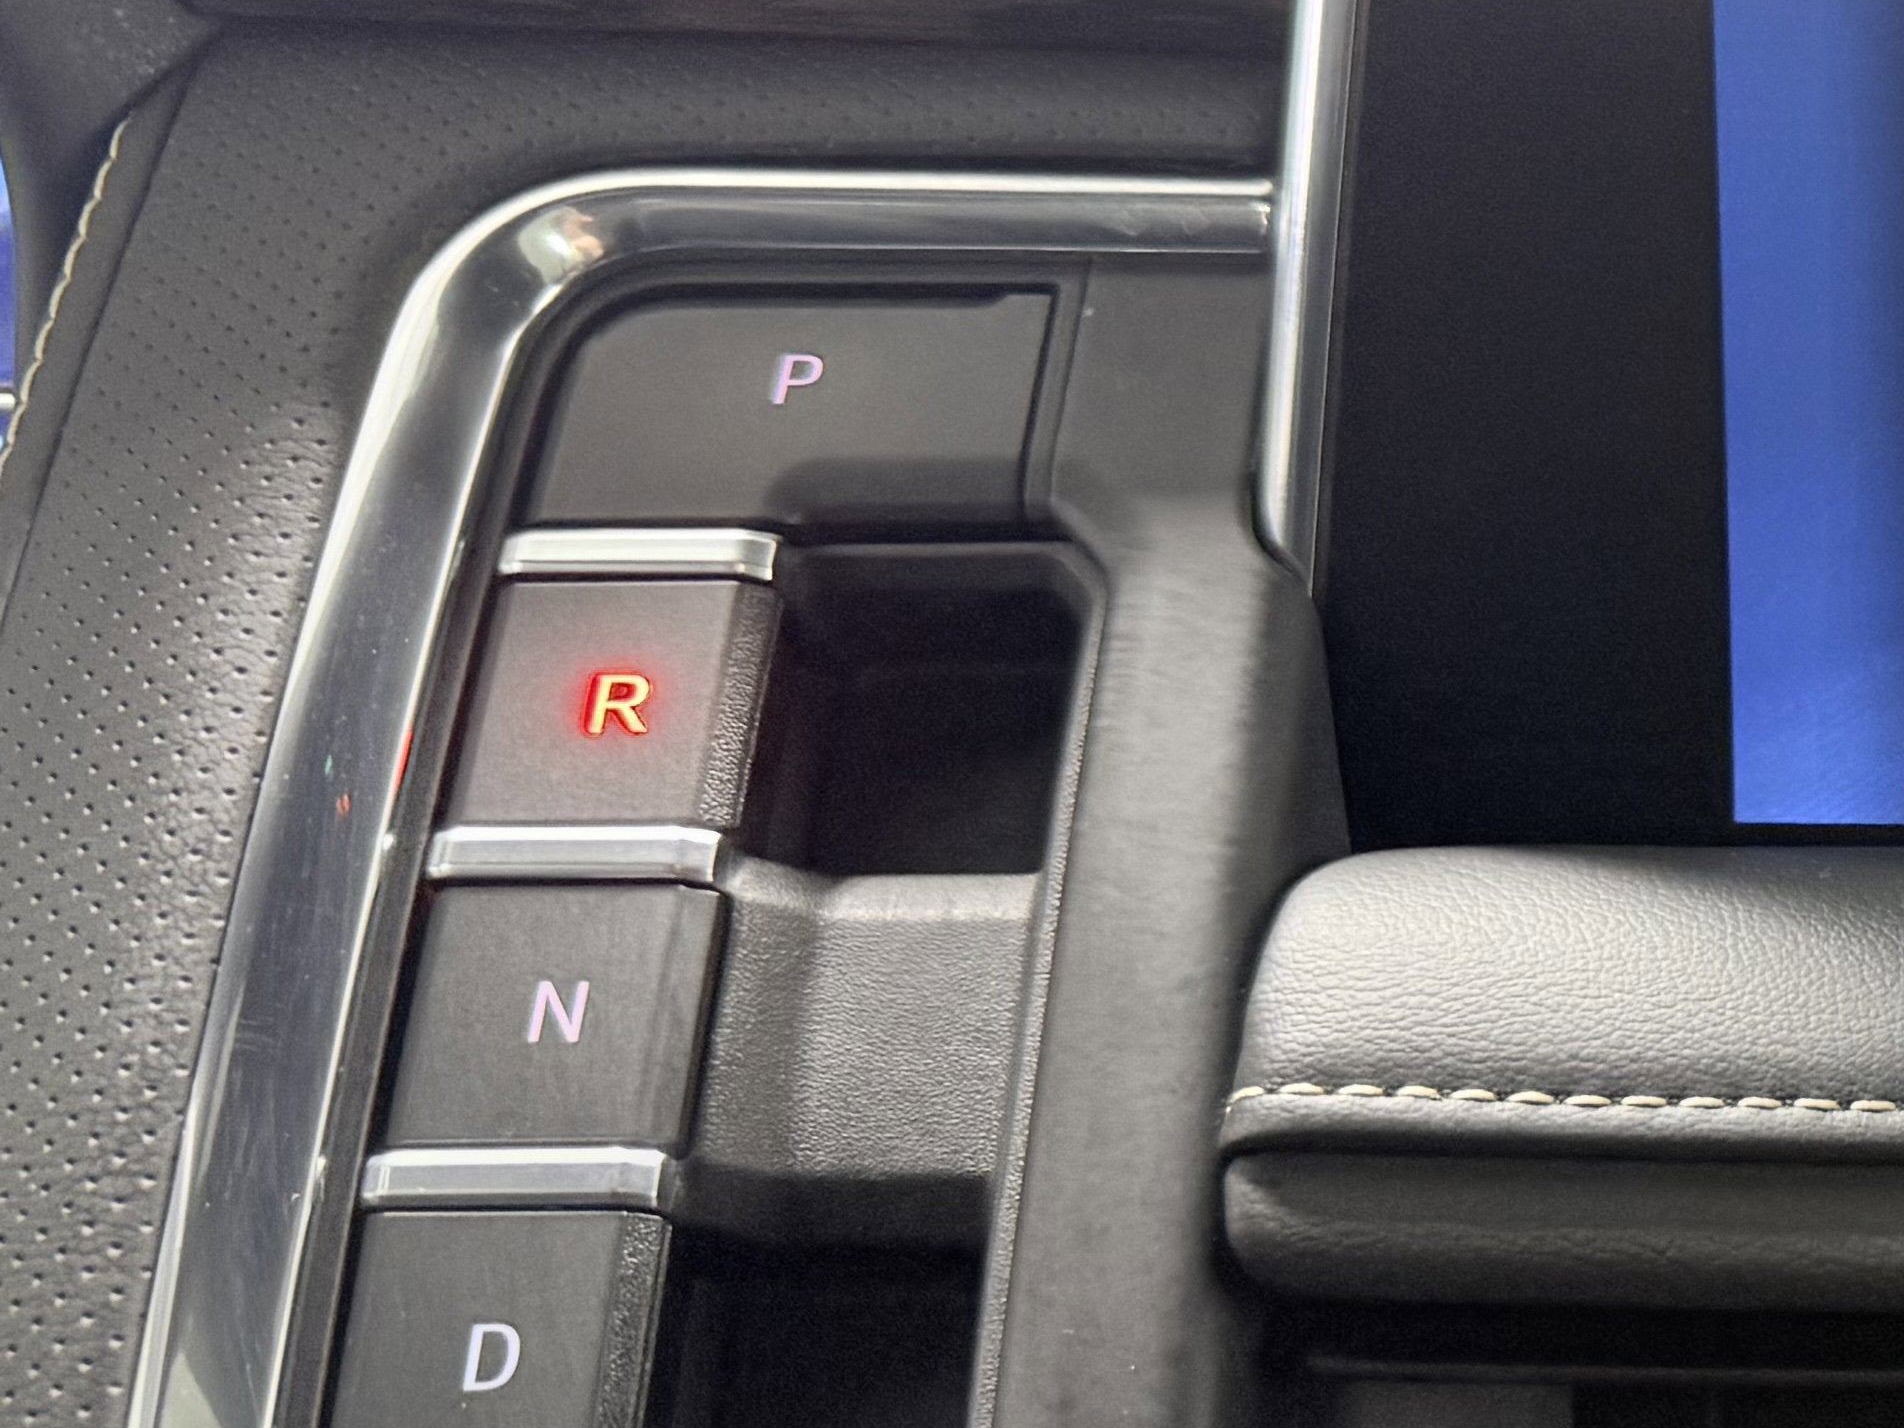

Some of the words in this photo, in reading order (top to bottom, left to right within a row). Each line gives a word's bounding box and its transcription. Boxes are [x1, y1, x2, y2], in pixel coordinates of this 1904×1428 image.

[770, 353, 824, 405] P
[579, 671, 652, 738] R
[527, 979, 591, 1044] N
[462, 1322, 521, 1393] D
